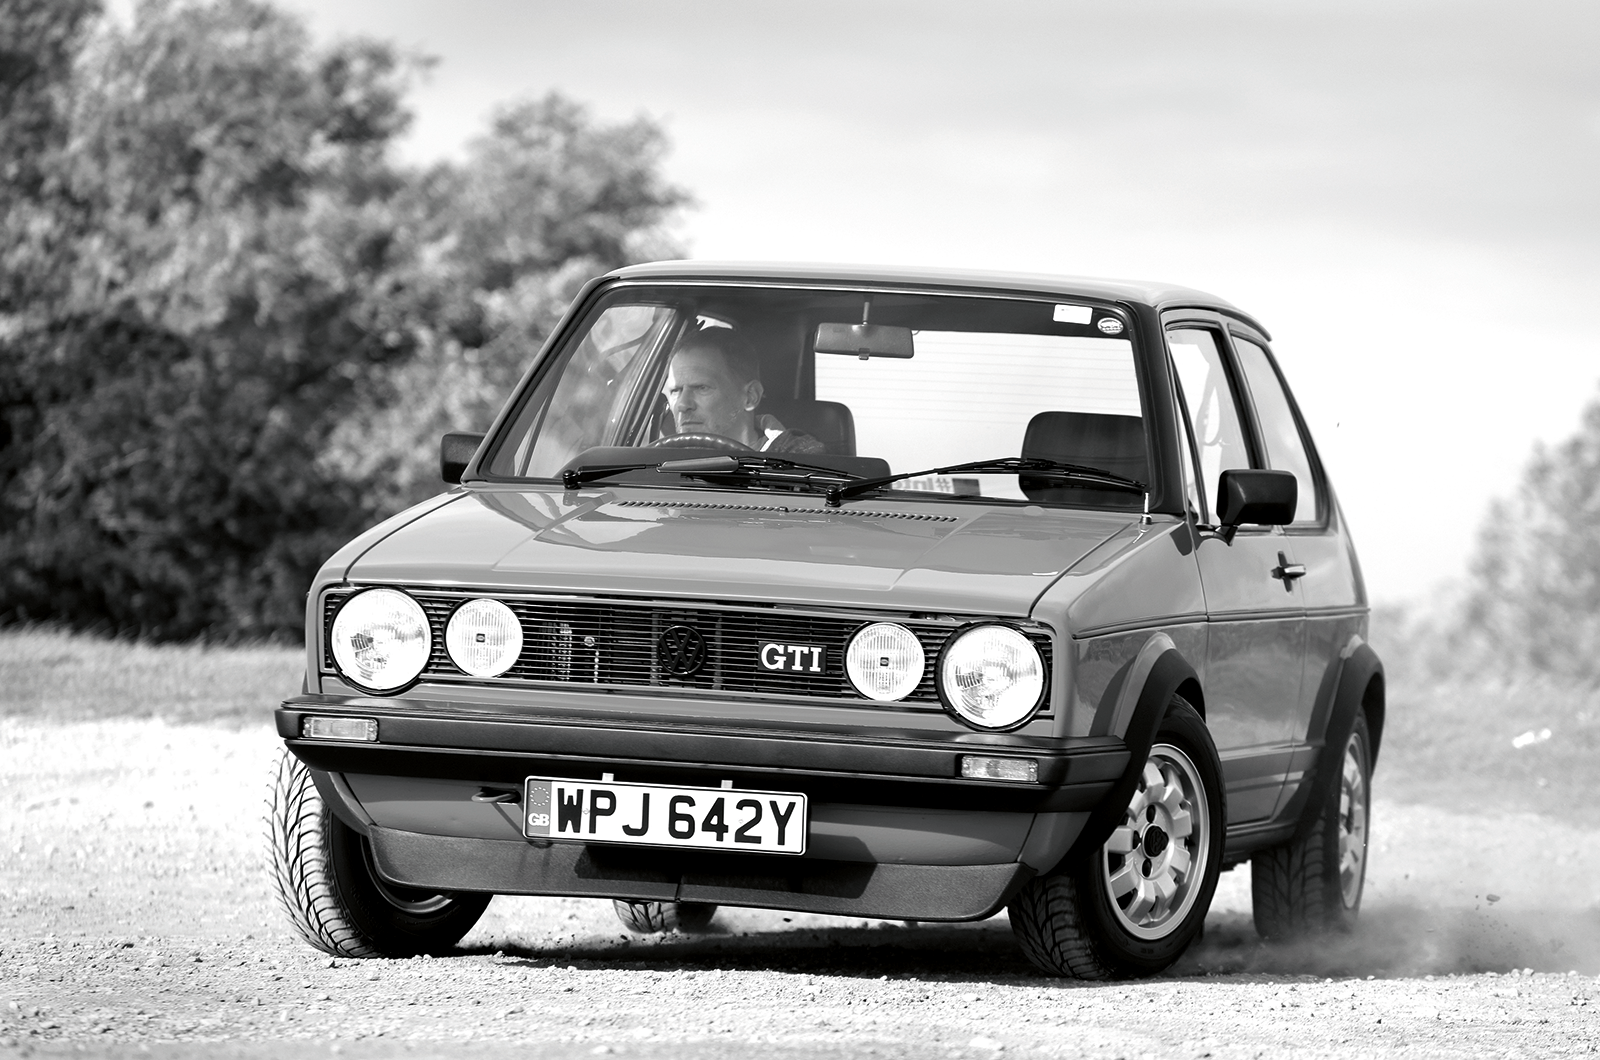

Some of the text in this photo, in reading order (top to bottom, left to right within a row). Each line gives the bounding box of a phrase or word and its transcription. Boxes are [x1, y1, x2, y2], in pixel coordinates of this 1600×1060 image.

[761, 643, 822, 672] GTI
[528, 813, 550, 826] GB
[557, 787, 796, 846] WPJ 642Y
